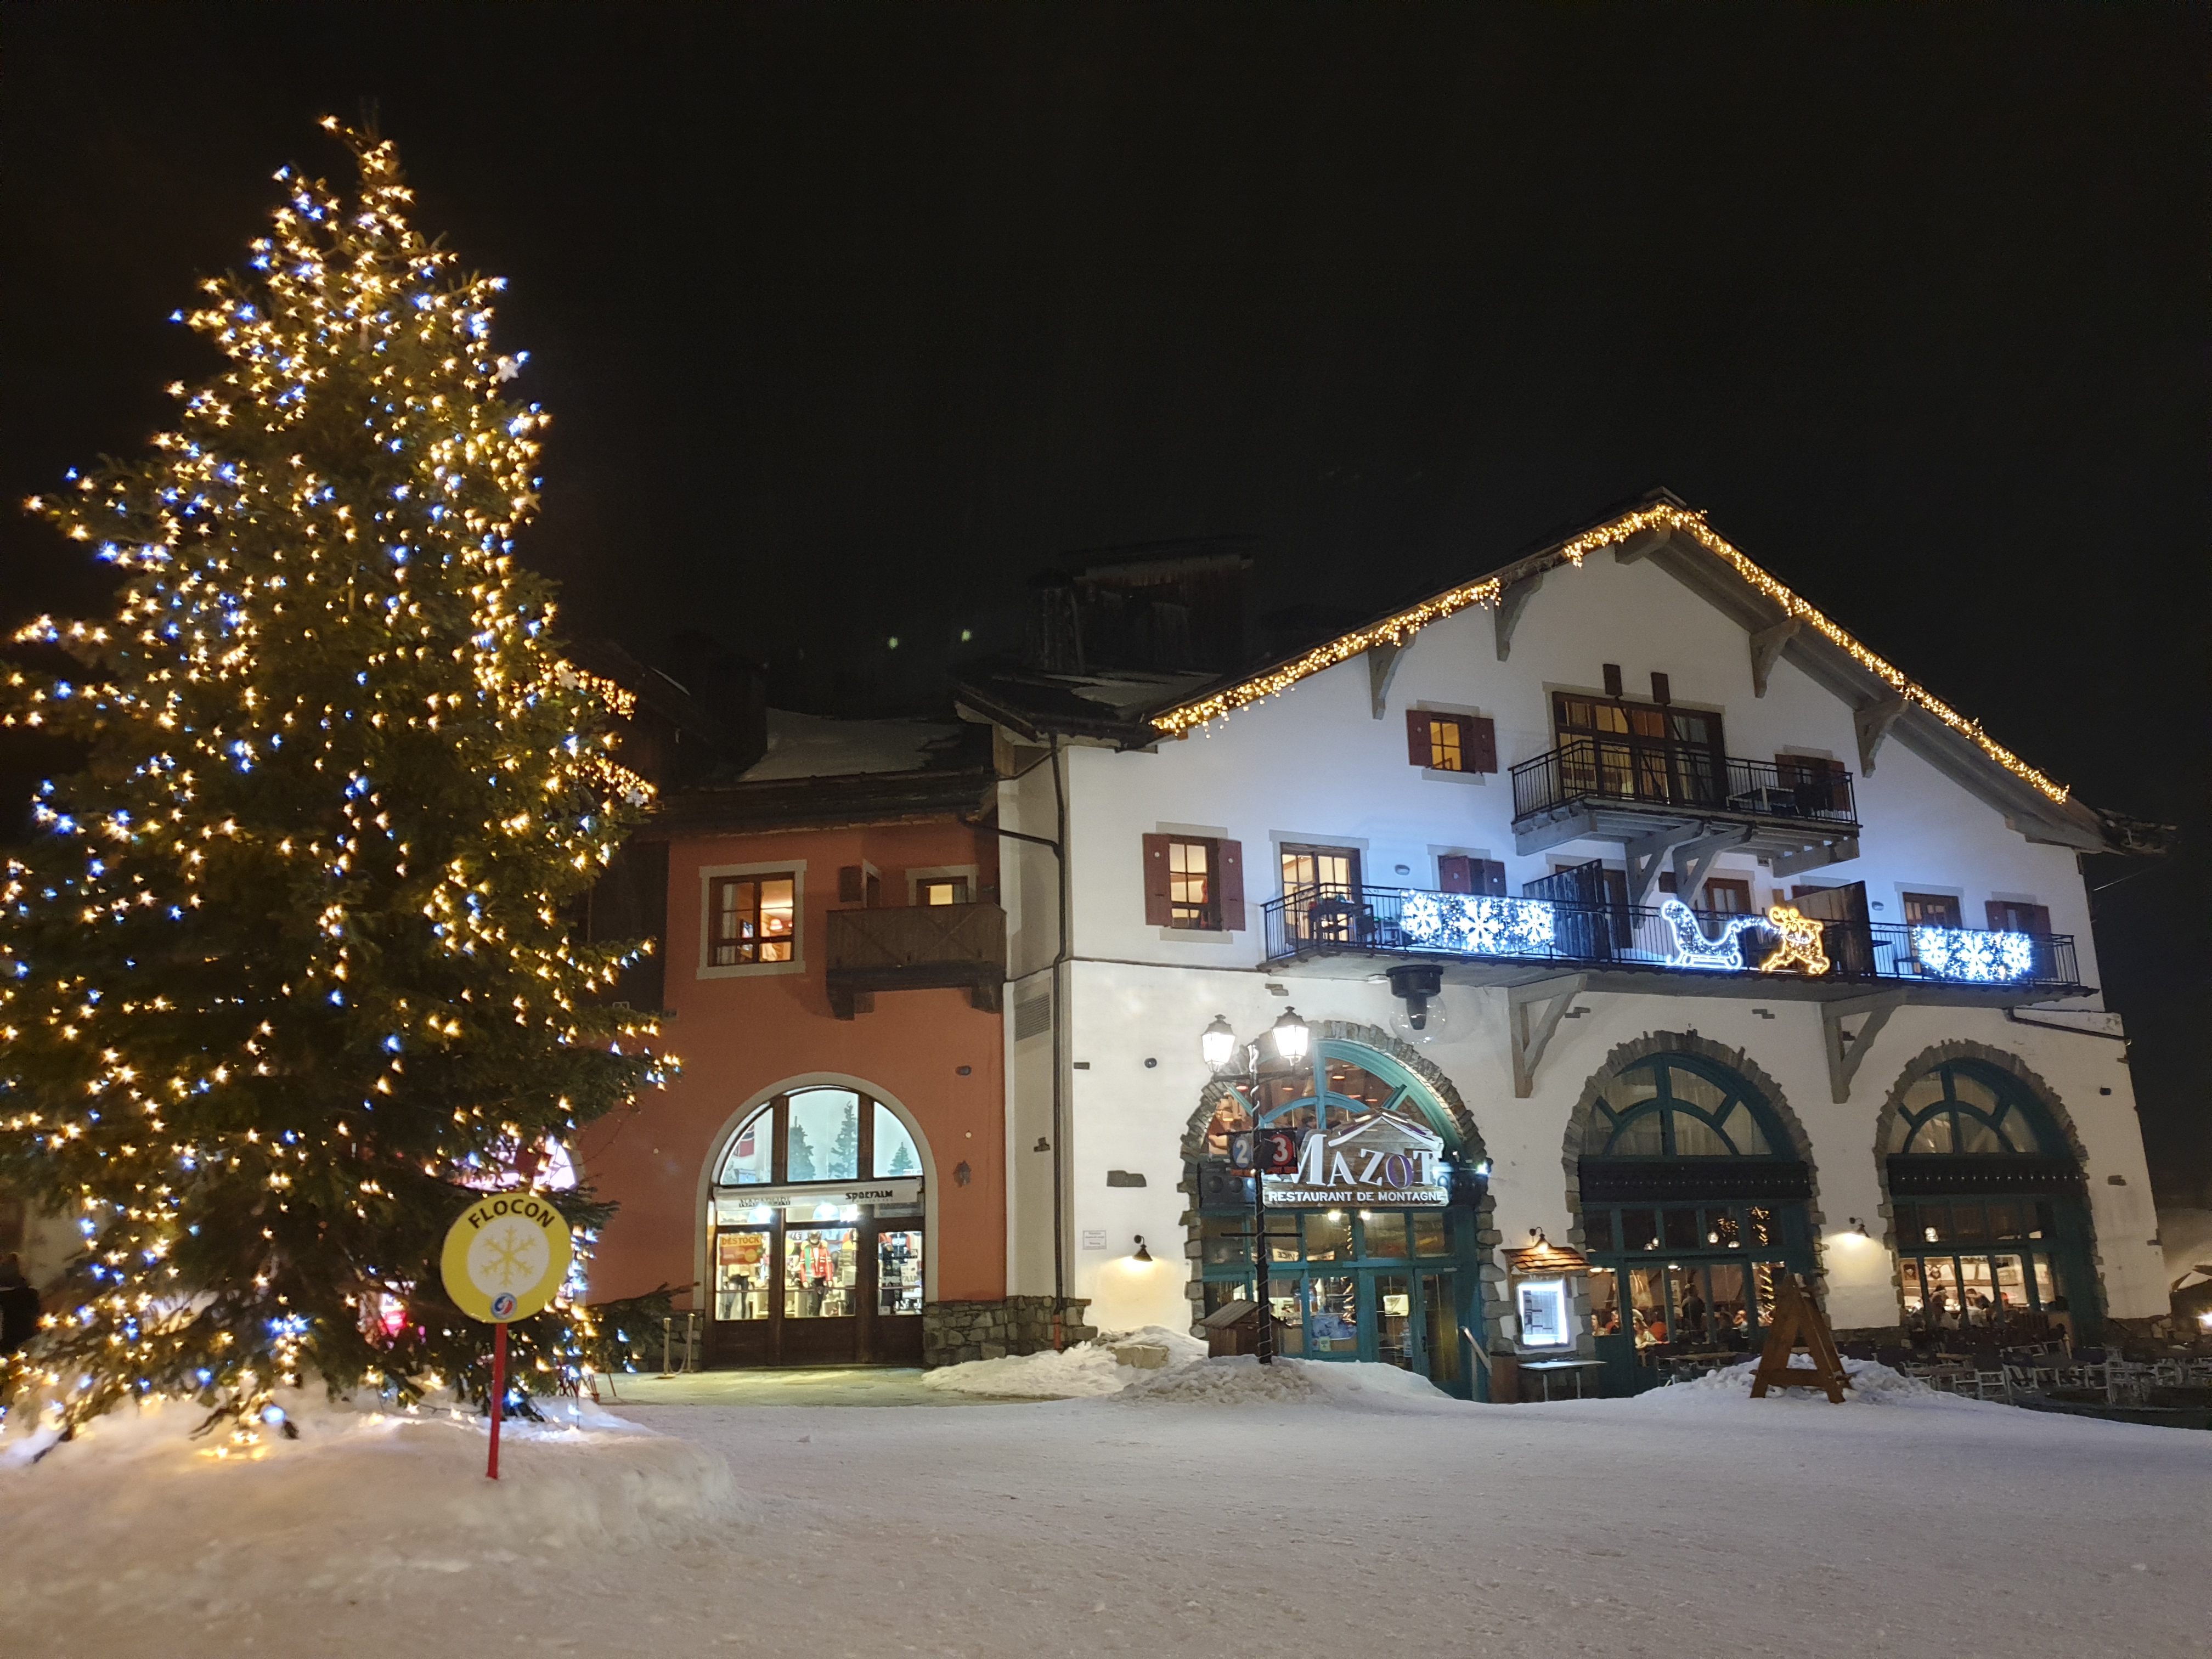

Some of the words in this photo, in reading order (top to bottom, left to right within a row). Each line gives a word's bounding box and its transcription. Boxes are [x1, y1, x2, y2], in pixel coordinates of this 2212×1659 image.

[1235, 1139, 1249, 1164] 2
[1266, 1133, 1437, 1189] MAZOT
[1272, 1137, 1288, 1162] 3
[1268, 1191, 1353, 1202] RESTAURANT
[1356, 1191, 1374, 1201] DE
[1378, 1191, 1445, 1202] MONTAGNE
[467, 1198, 555, 1229] FLOCON
